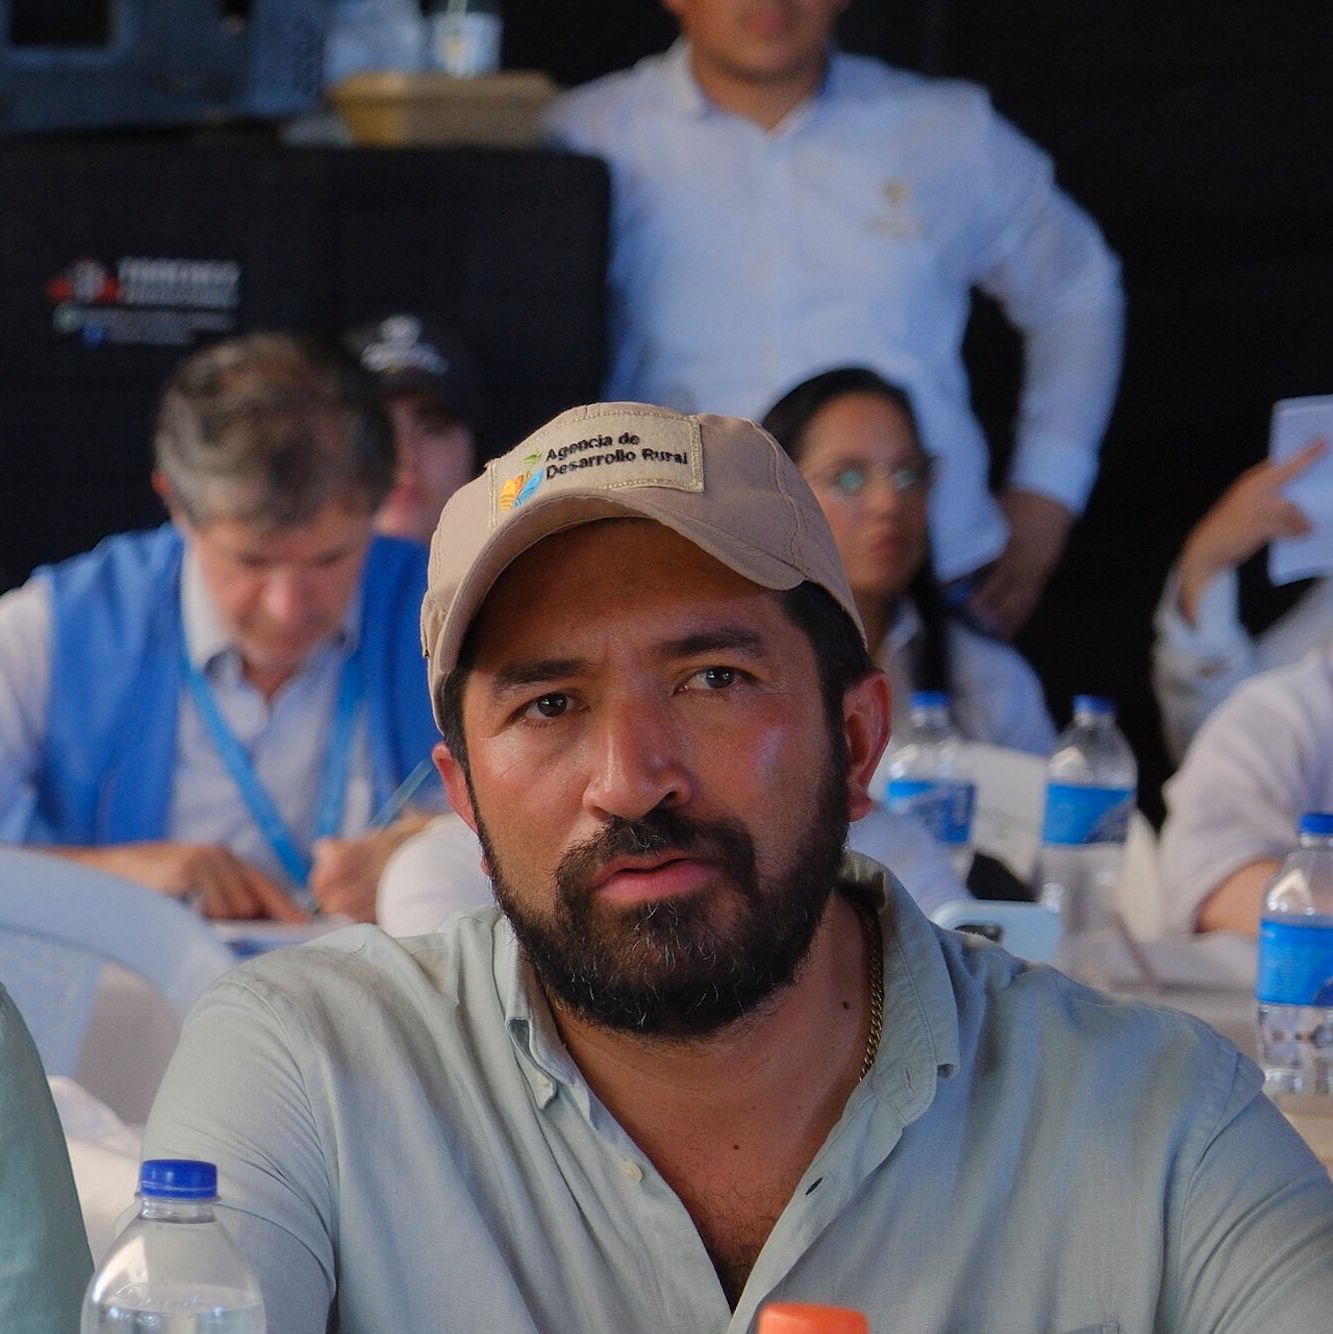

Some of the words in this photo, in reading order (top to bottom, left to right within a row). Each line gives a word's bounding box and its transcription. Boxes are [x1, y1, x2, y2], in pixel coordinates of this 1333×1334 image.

[546, 434, 613, 462] Agencia
[618, 432, 640, 446] de
[545, 449, 637, 479] Desarrollo
[642, 447, 689, 466] Rural
